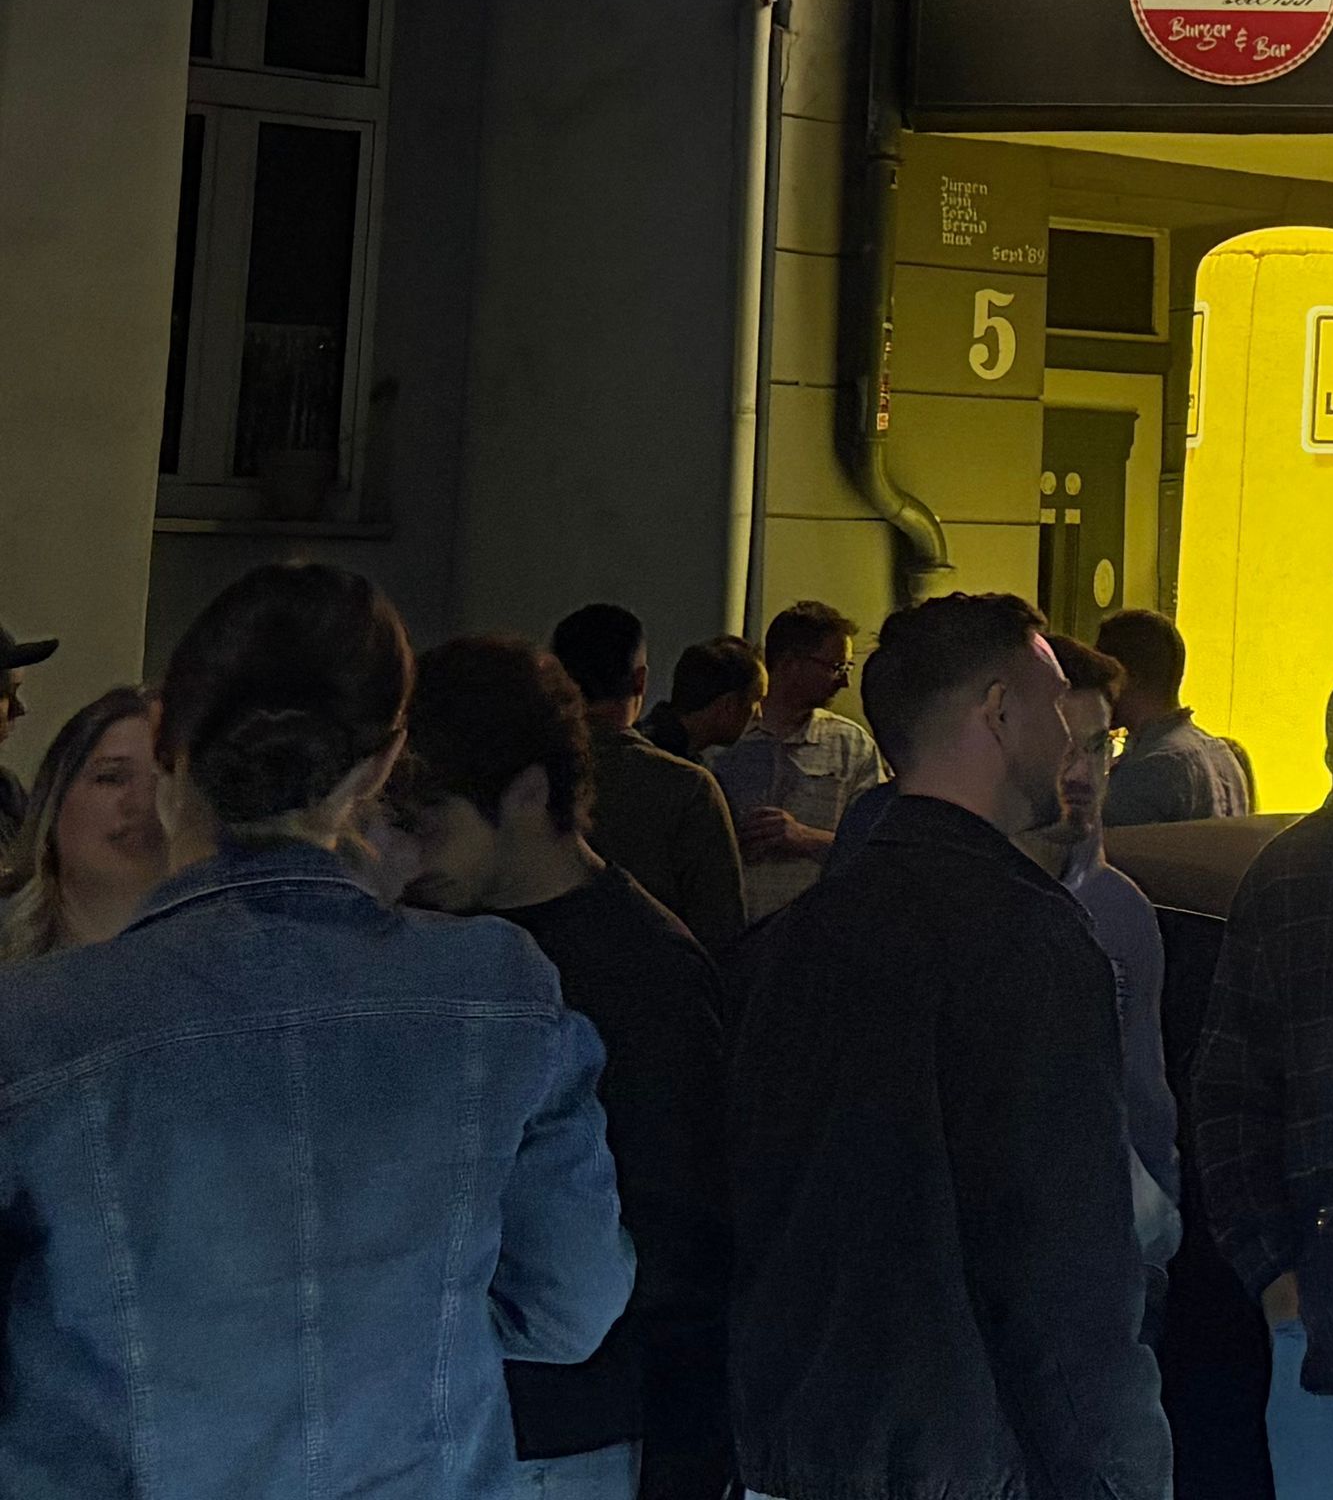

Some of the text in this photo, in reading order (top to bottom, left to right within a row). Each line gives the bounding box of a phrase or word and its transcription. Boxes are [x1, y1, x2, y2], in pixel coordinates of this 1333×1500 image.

[1168, 16, 1232, 50] Burger
[1253, 36, 1291, 60] Bar
[968, 288, 1016, 380] 5
